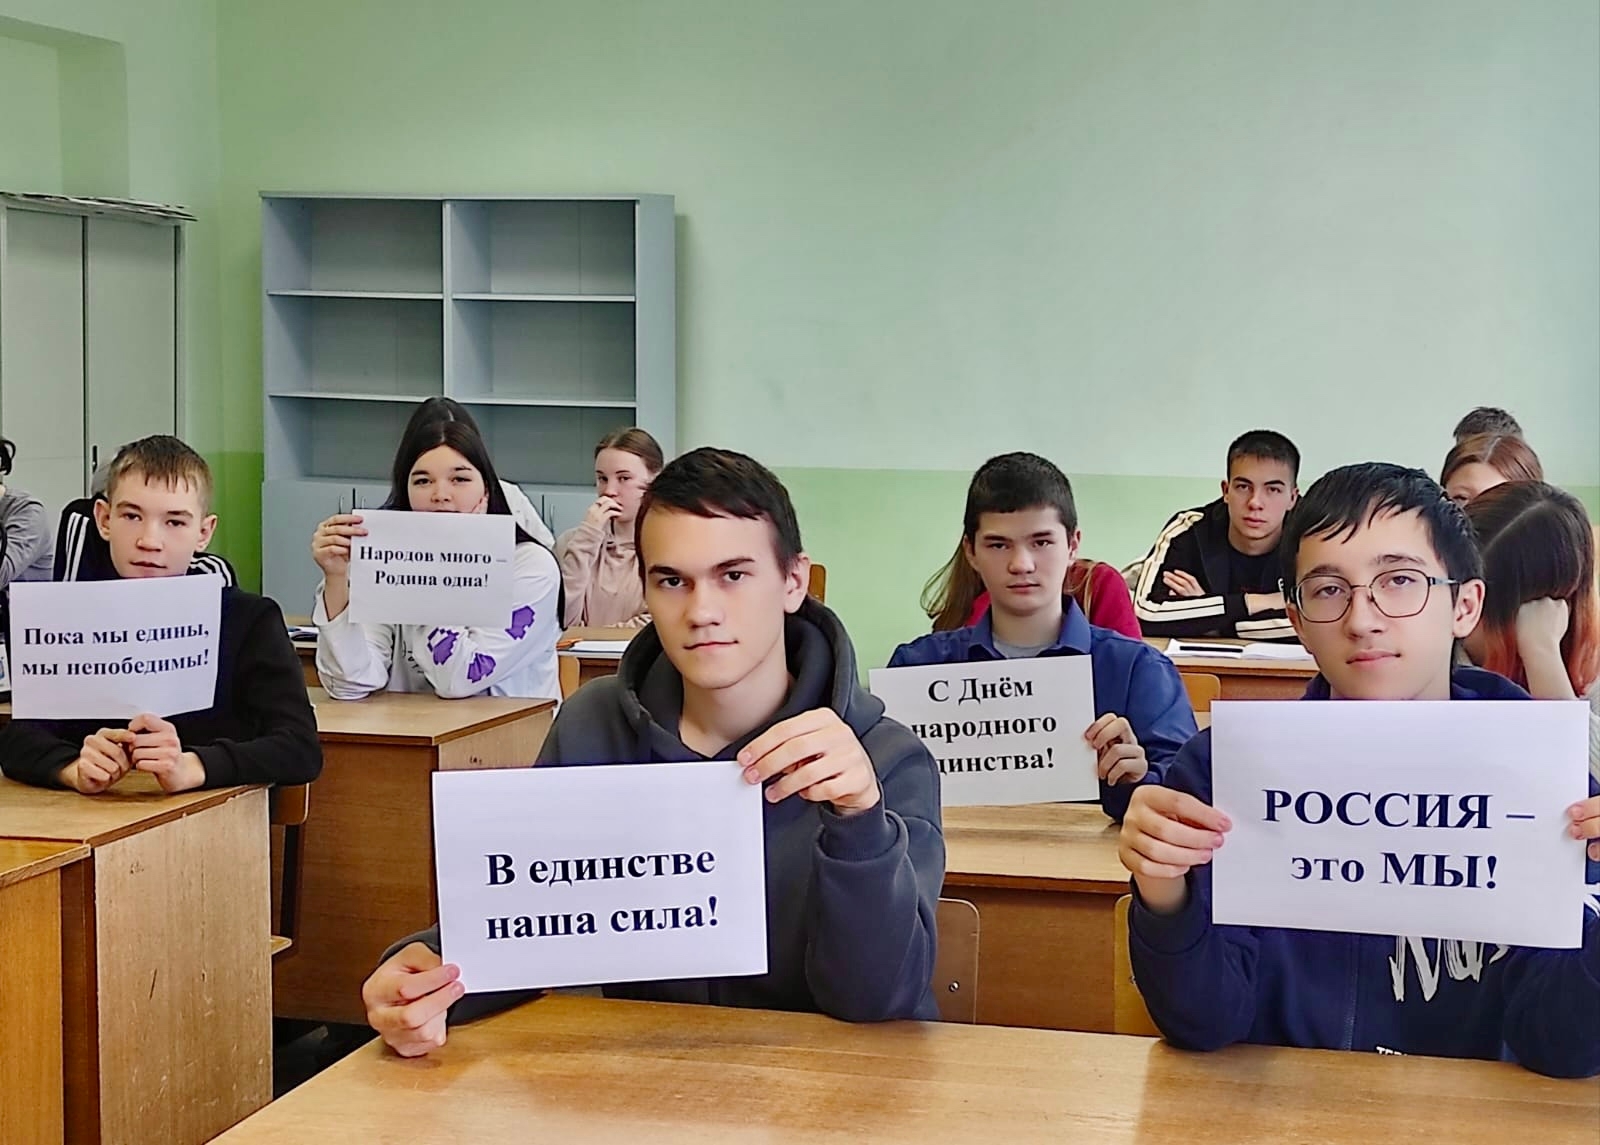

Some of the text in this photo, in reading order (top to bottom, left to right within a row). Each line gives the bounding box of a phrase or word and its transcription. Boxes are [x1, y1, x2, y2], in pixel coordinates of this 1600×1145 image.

[360, 546, 434, 564] Народов
[440, 552, 491, 564] много
[375, 570, 488, 588] Родина одна!
[24, 624, 209, 645] Пока мы едины,
[22, 649, 208, 675] мы непобедимы!
[928, 677, 1033, 706] С Днём
[911, 717, 1056, 745] народного
[1261, 789, 1493, 829] РОССИЯ
[484, 852, 715, 888] В единстве
[1291, 852, 1497, 889] это МЫ!
[485, 896, 717, 940] наша сила!
